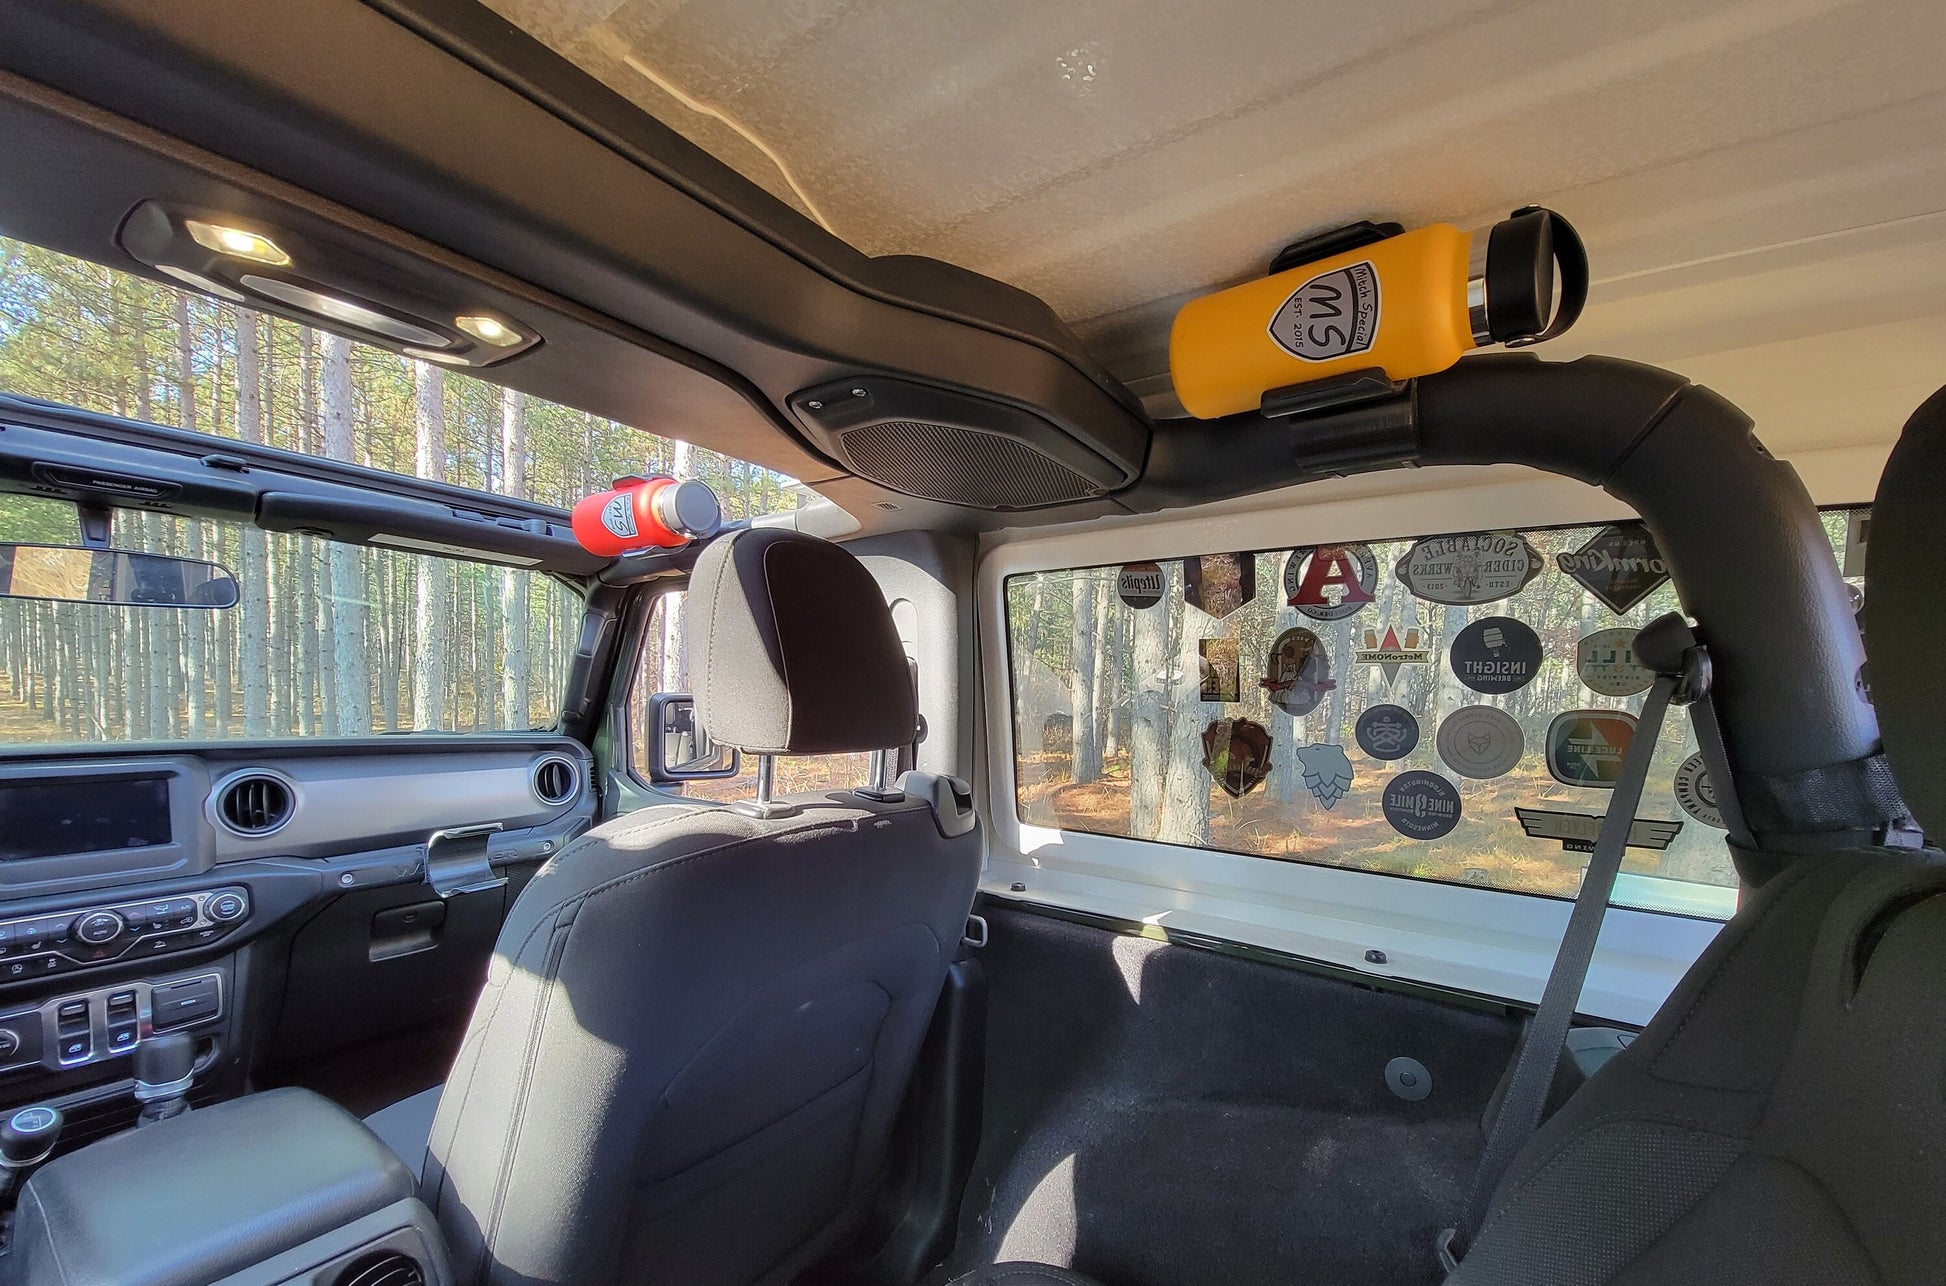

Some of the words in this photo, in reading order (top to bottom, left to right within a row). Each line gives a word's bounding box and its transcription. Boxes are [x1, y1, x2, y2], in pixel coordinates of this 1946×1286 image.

[1355, 268, 1371, 299] Mitch
[1307, 284, 1346, 347] MS
[1355, 302, 1373, 346] Special
[1293, 323, 1304, 348] 2015
[93, 480, 132, 489] PASSENGER
